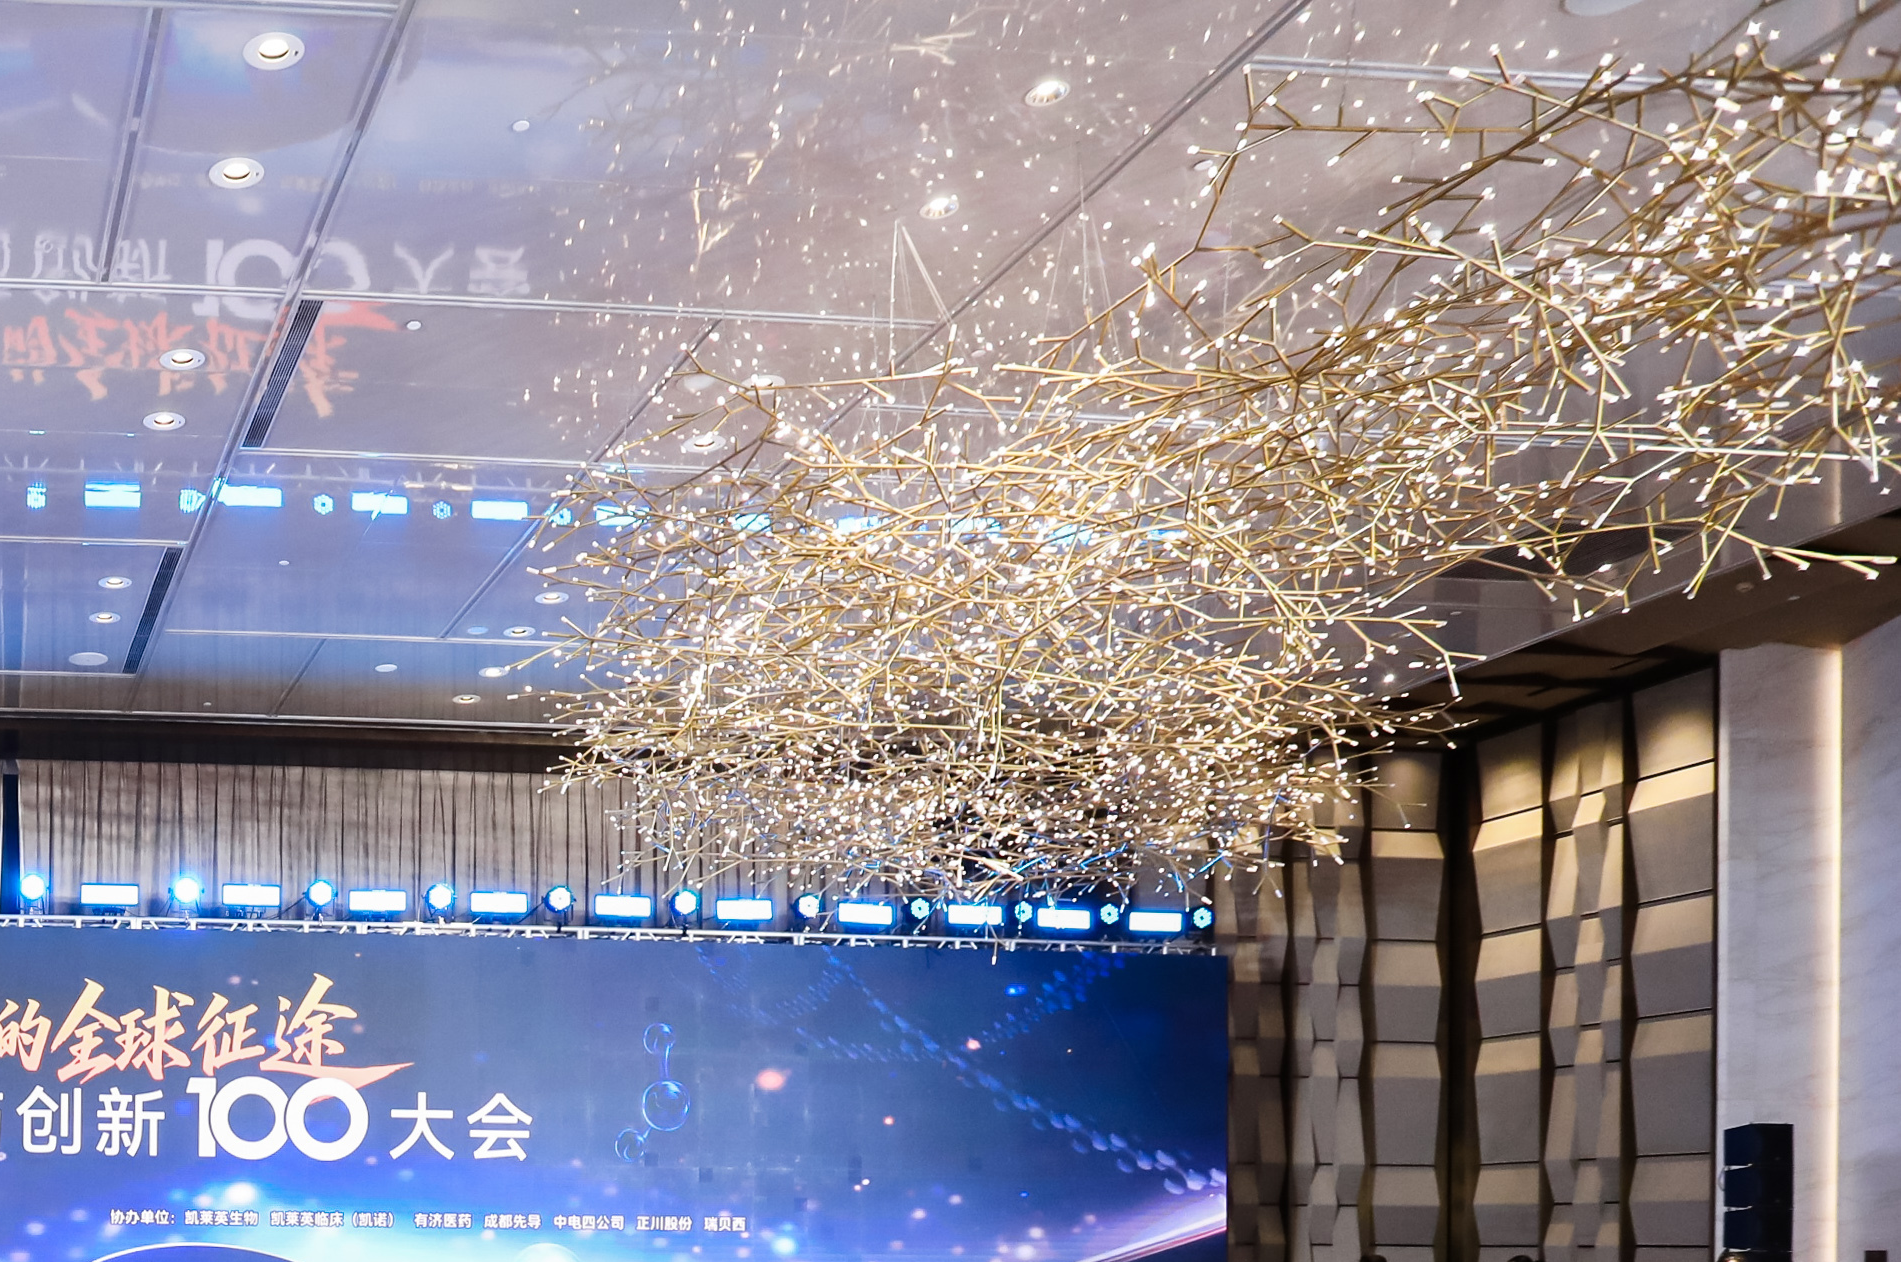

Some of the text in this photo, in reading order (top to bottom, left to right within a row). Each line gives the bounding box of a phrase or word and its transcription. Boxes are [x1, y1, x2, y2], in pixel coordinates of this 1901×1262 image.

[414, 1212, 472, 1229] 有济医药
[484, 1213, 541, 1229] 成都先导
[553, 1213, 624, 1231] 中电四公司
[636, 1214, 692, 1231] 正川股份
[704, 1215, 746, 1232] 瑞贝西
